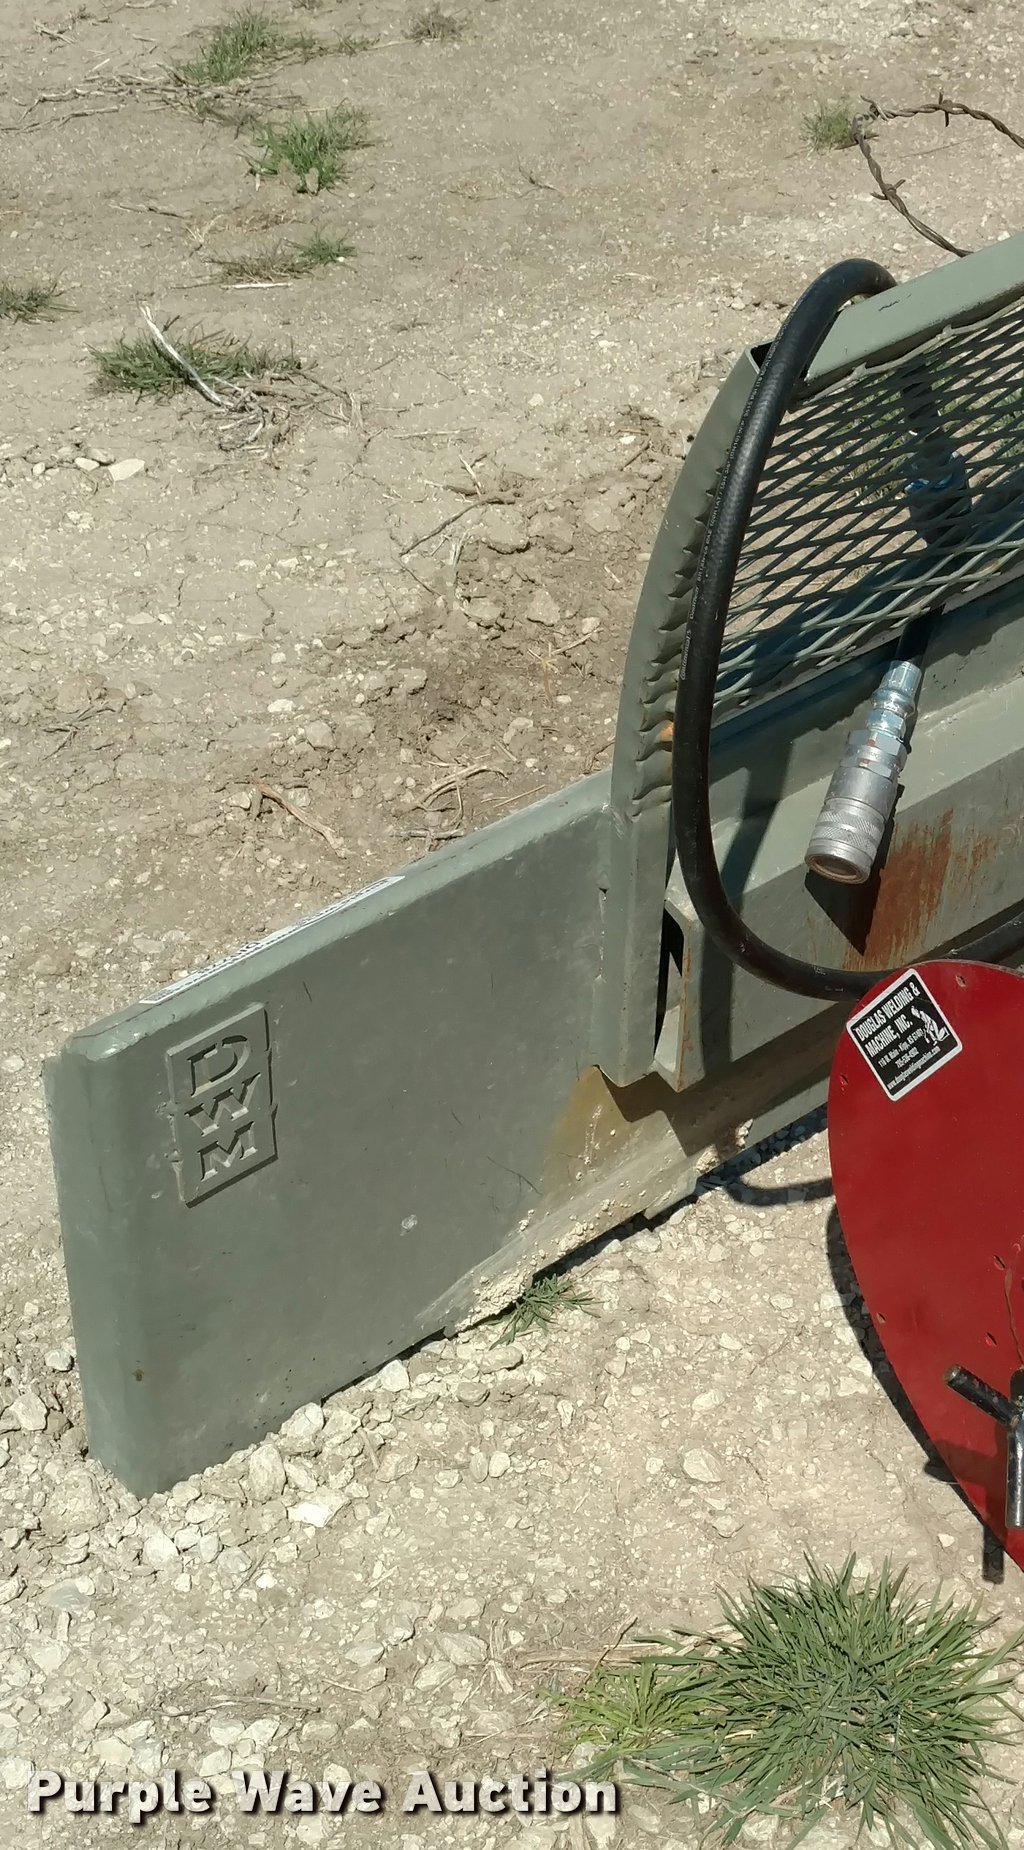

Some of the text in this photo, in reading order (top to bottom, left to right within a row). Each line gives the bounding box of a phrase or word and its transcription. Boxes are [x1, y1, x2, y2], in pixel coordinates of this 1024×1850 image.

[855, 981, 921, 1042] DOUGLAS WELDING &
[864, 1013, 913, 1058] MACHINE, INC.
